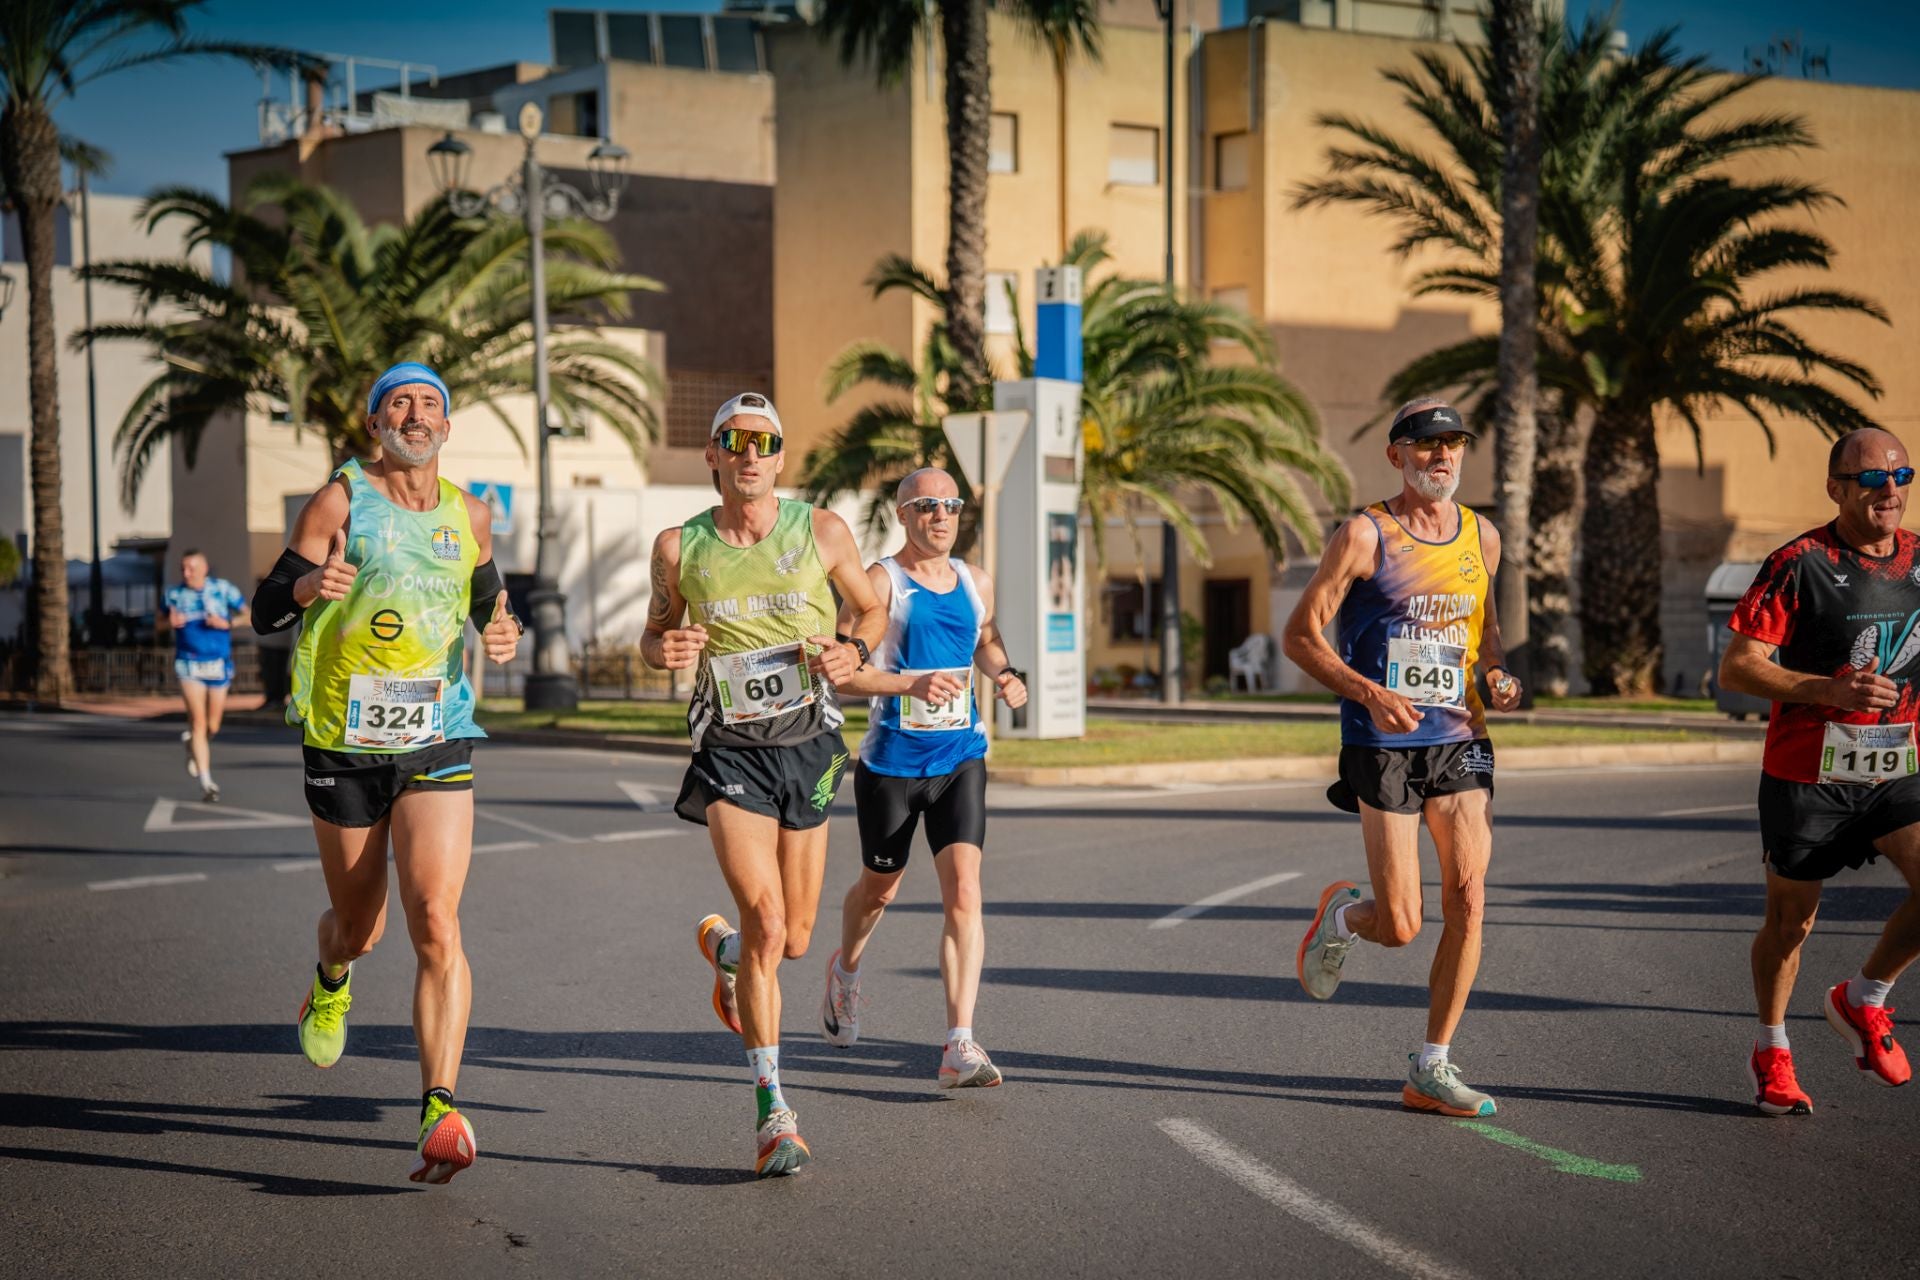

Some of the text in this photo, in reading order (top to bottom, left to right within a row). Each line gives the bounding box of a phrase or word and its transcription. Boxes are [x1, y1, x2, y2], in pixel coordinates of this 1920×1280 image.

[699, 598, 739, 620] TEAM
[1406, 594, 1477, 622] ATLETISMO
[1846, 611, 1905, 621] entrenamiento
[741, 651, 773, 664] MEDIA
[384, 681, 417, 693] MEDIA
[744, 674, 784, 701] 60
[1404, 666, 1454, 690] 649
[366, 705, 424, 730] 324
[1858, 728, 1892, 739] MEDIA
[1842, 751, 1899, 772] 119
